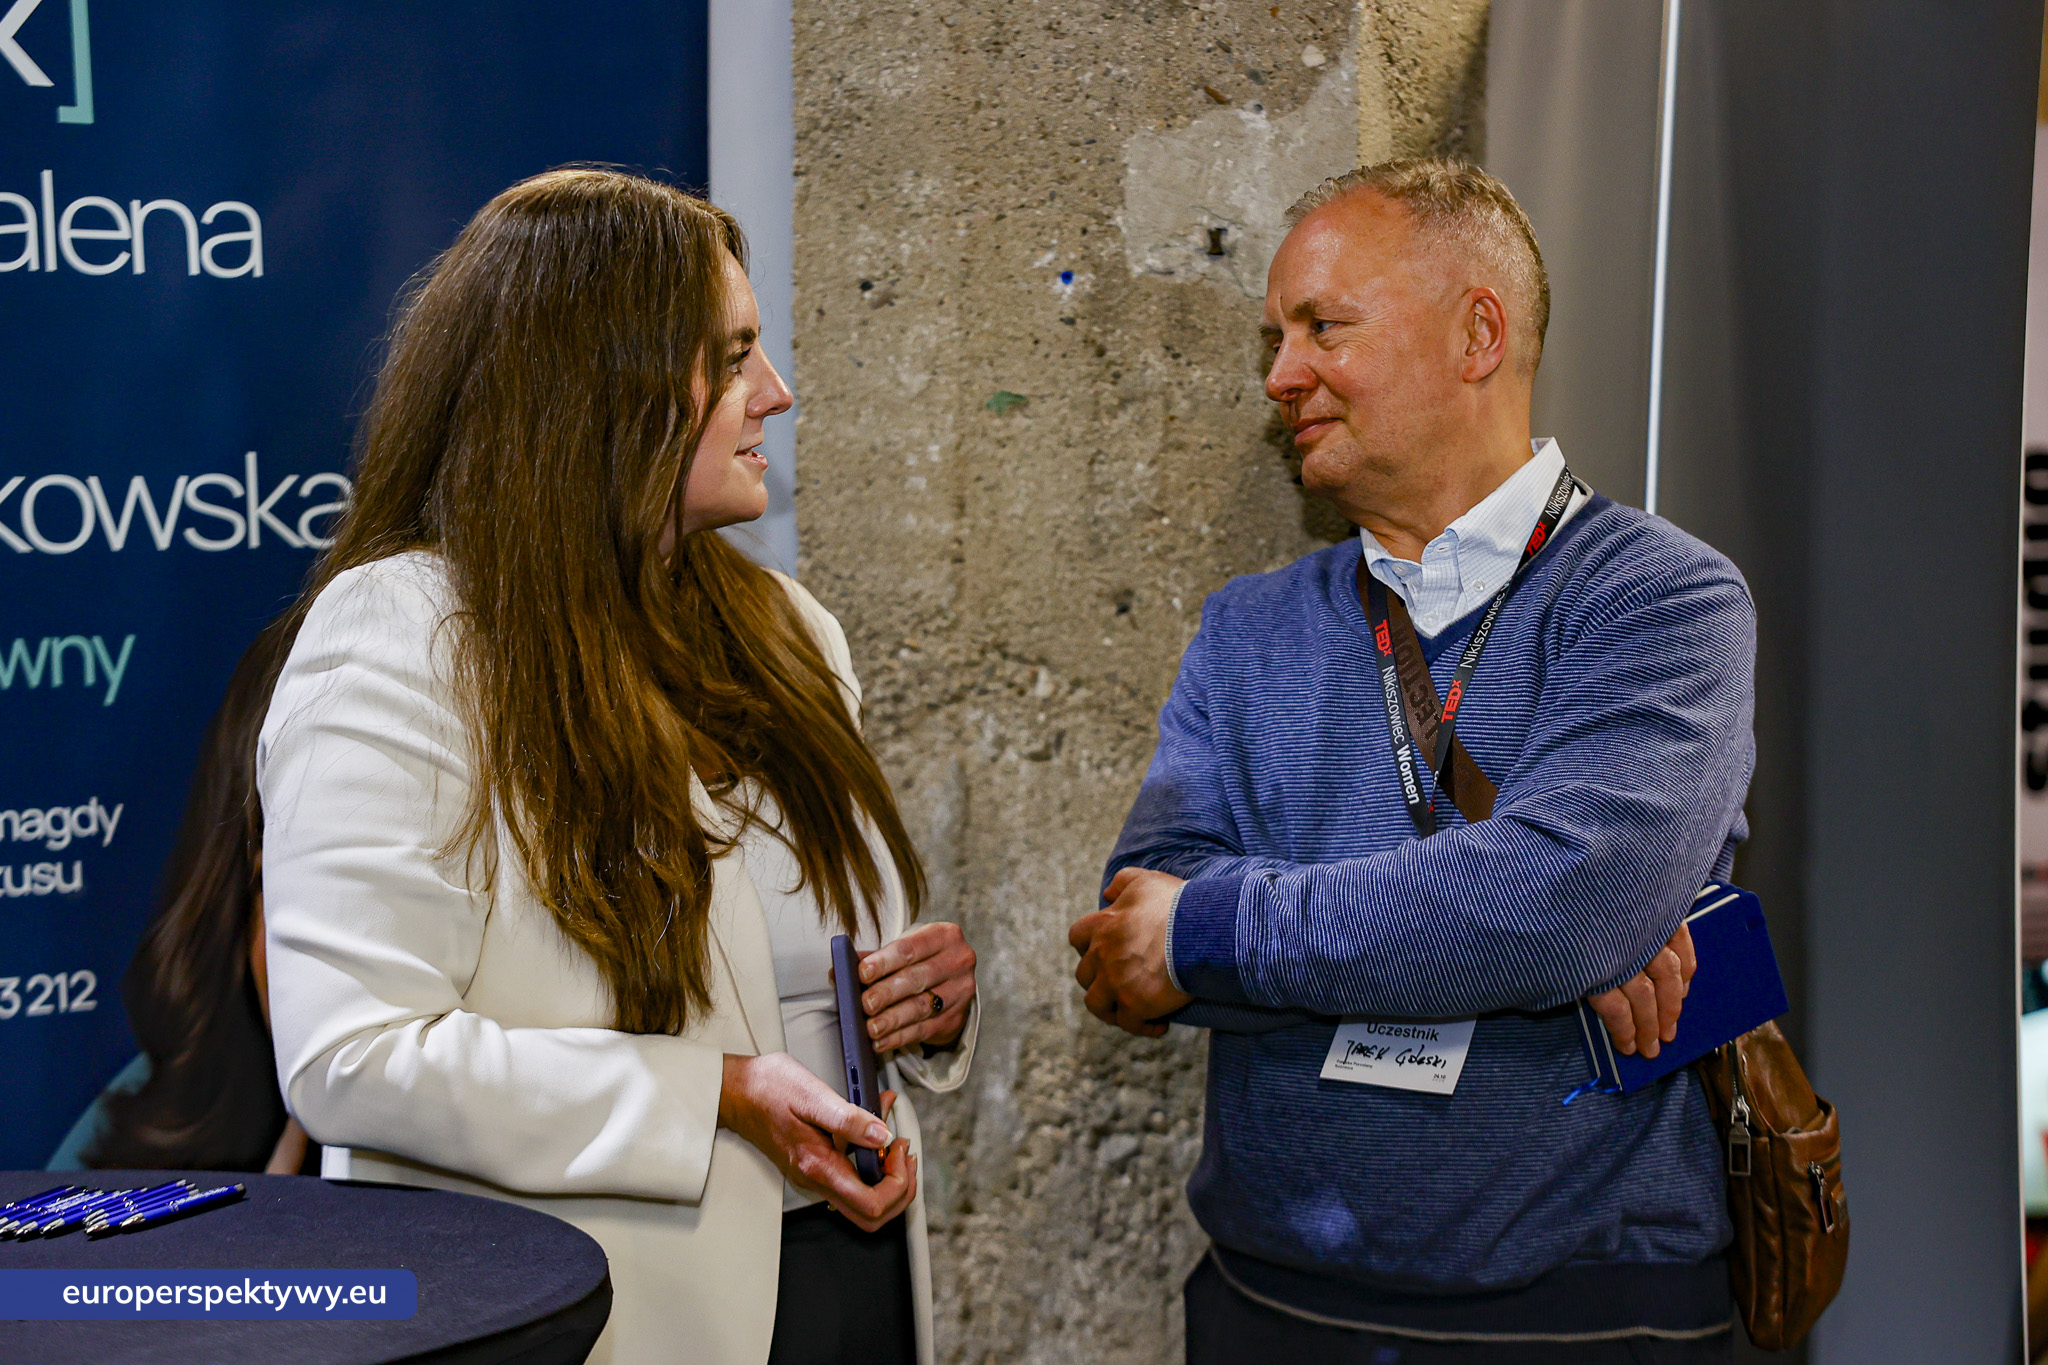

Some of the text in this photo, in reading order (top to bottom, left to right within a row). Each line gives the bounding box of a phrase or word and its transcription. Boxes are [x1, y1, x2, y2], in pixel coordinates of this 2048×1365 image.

[0, 169, 264, 278] alena
[1460, 593, 1505, 669] Nikiszowiec
[1382, 665, 1405, 745] Nikiszowiec
[1396, 744, 1420, 804] Women
[0, 860, 83, 897] usu
[1366, 1022, 1440, 1042] Uczestnik
